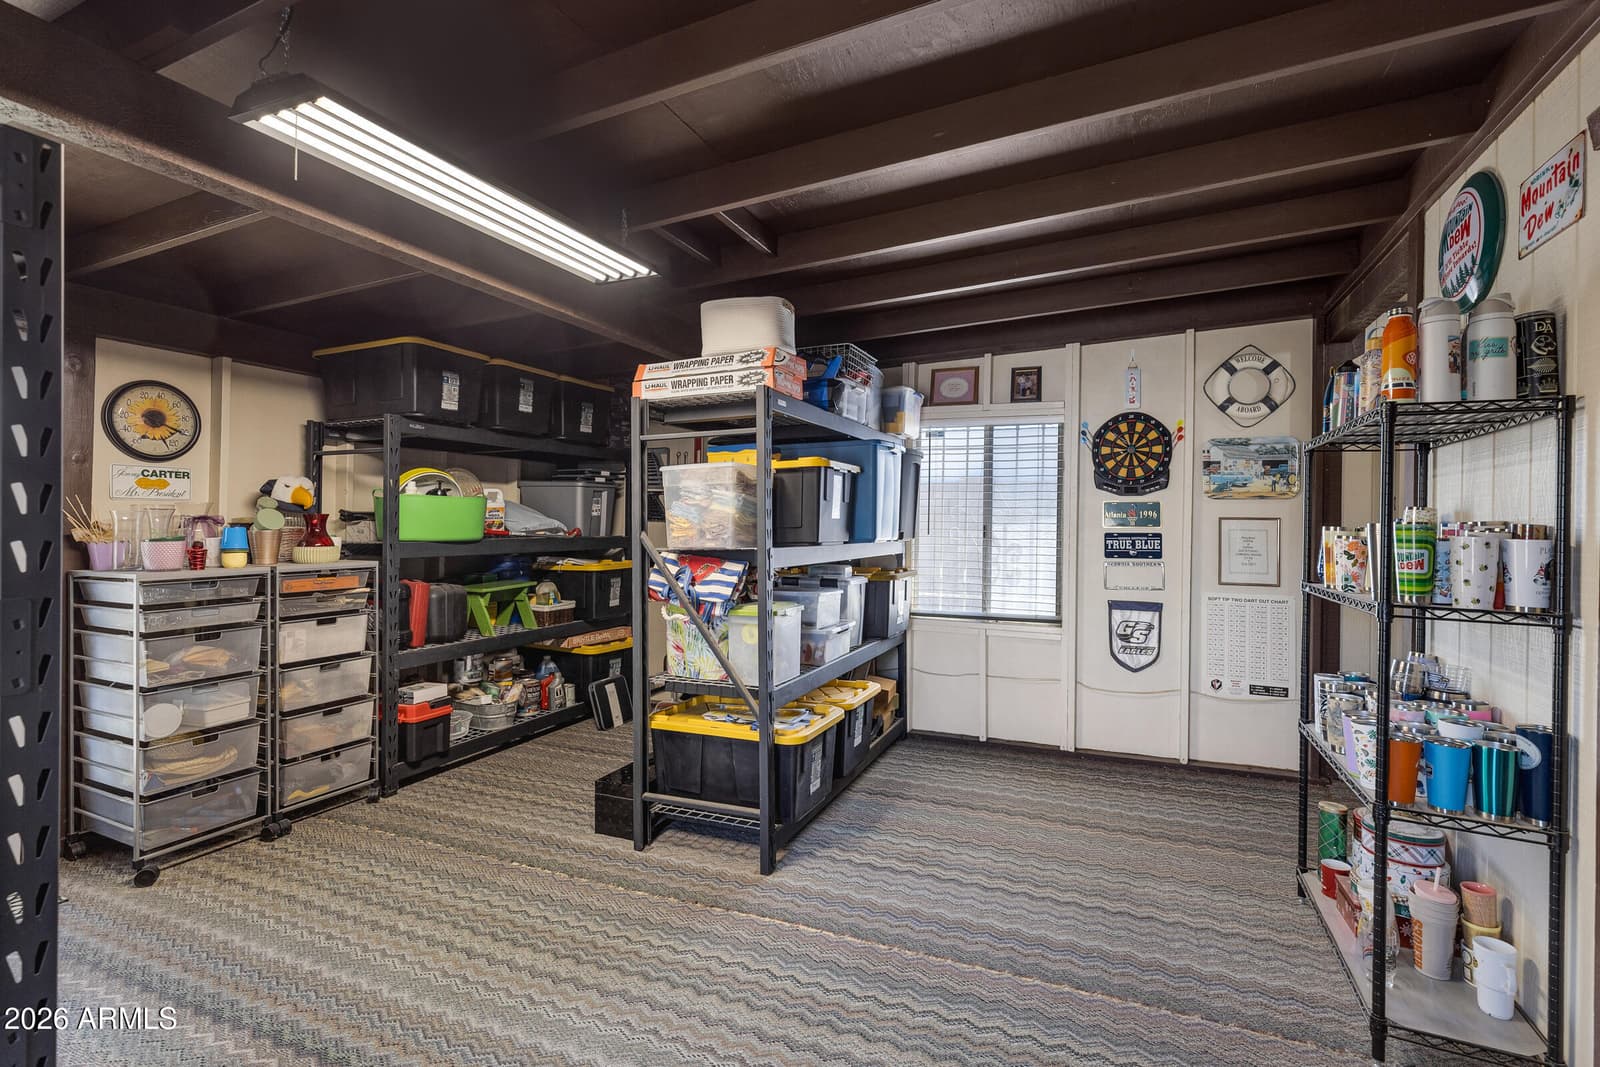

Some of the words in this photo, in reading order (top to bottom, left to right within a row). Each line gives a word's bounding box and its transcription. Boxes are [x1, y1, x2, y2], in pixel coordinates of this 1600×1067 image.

[1521, 149, 1580, 217] Mountain
[1523, 202, 1555, 241] Dew
[673, 359, 709, 370] WRAPPING
[711, 355, 735, 365] PAPER
[1235, 355, 1266, 364] WELCOME
[671, 378, 708, 390] WRAPPING
[710, 375, 734, 386] PAPER
[1237, 405, 1262, 414] ABOARD
[141, 468, 190, 480] CARTER
[143, 488, 187, 499] President
[1139, 510, 1157, 519] 1996
[1106, 540, 1132, 549] TRUE
[1135, 540, 1161, 549] BLUE
